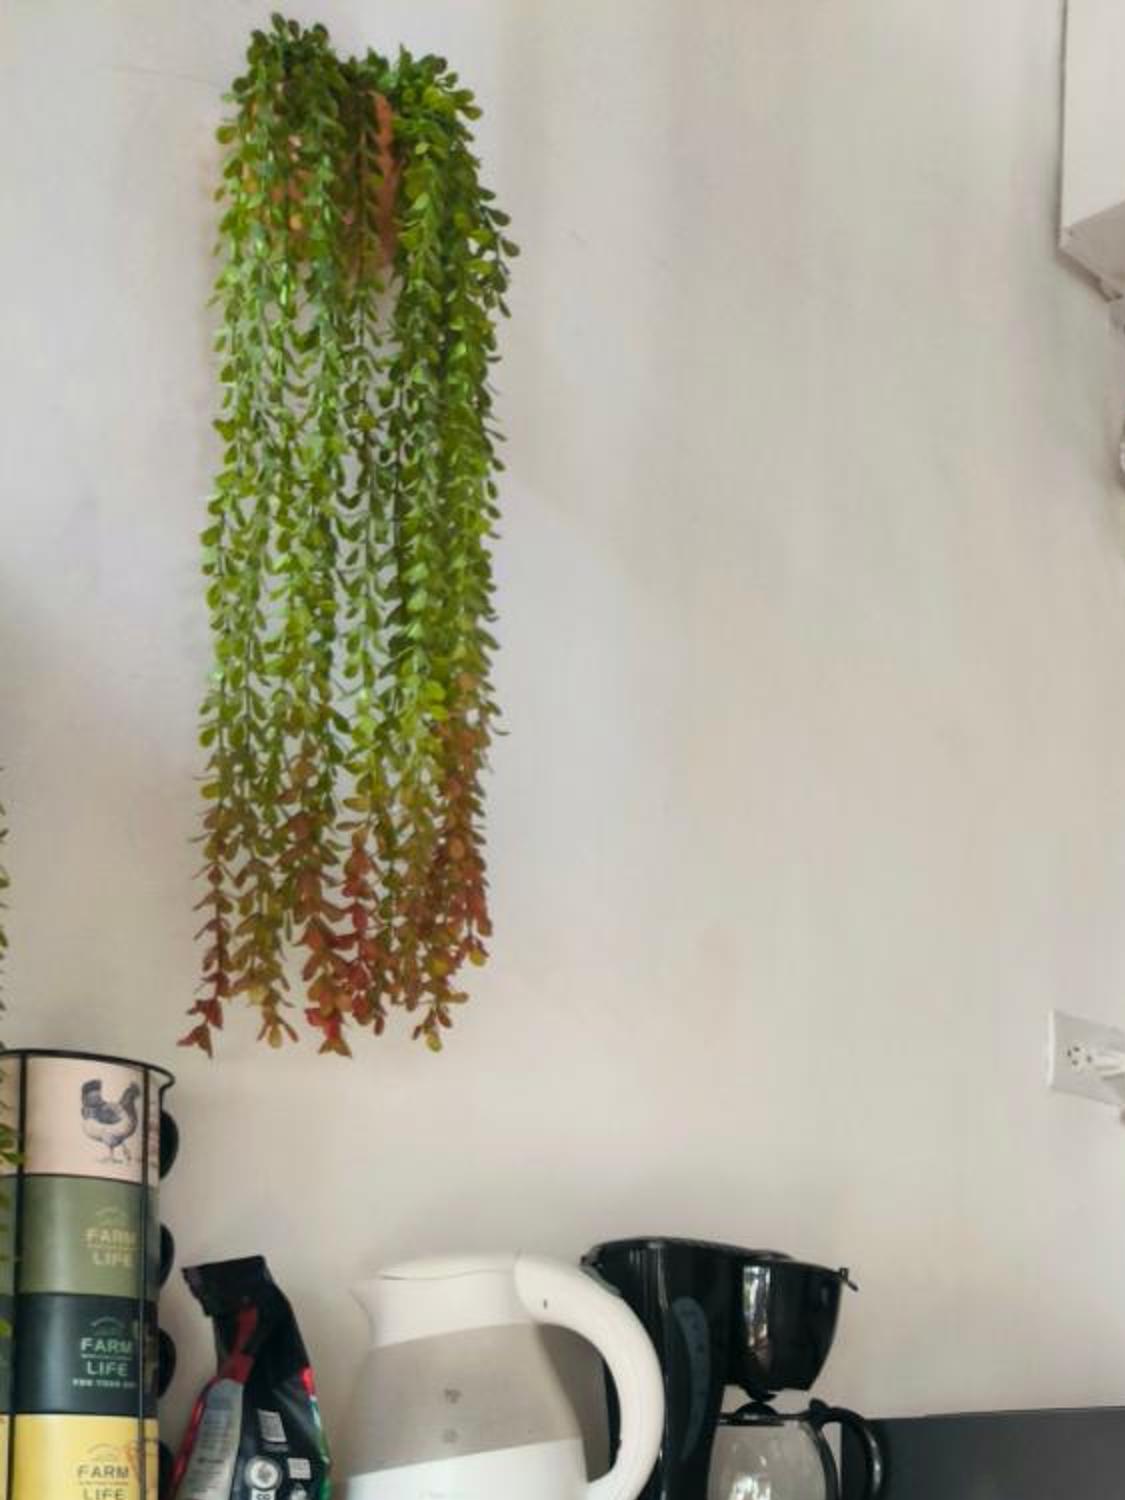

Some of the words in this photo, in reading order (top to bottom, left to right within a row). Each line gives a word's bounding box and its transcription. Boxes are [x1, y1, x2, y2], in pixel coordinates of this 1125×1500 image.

[86, 1228, 137, 1246] FARM
[92, 1251, 134, 1267] LIFE
[80, 1337, 132, 1354] FARM
[86, 1360, 128, 1377] LIFE
[78, 1464, 130, 1480] FARM
